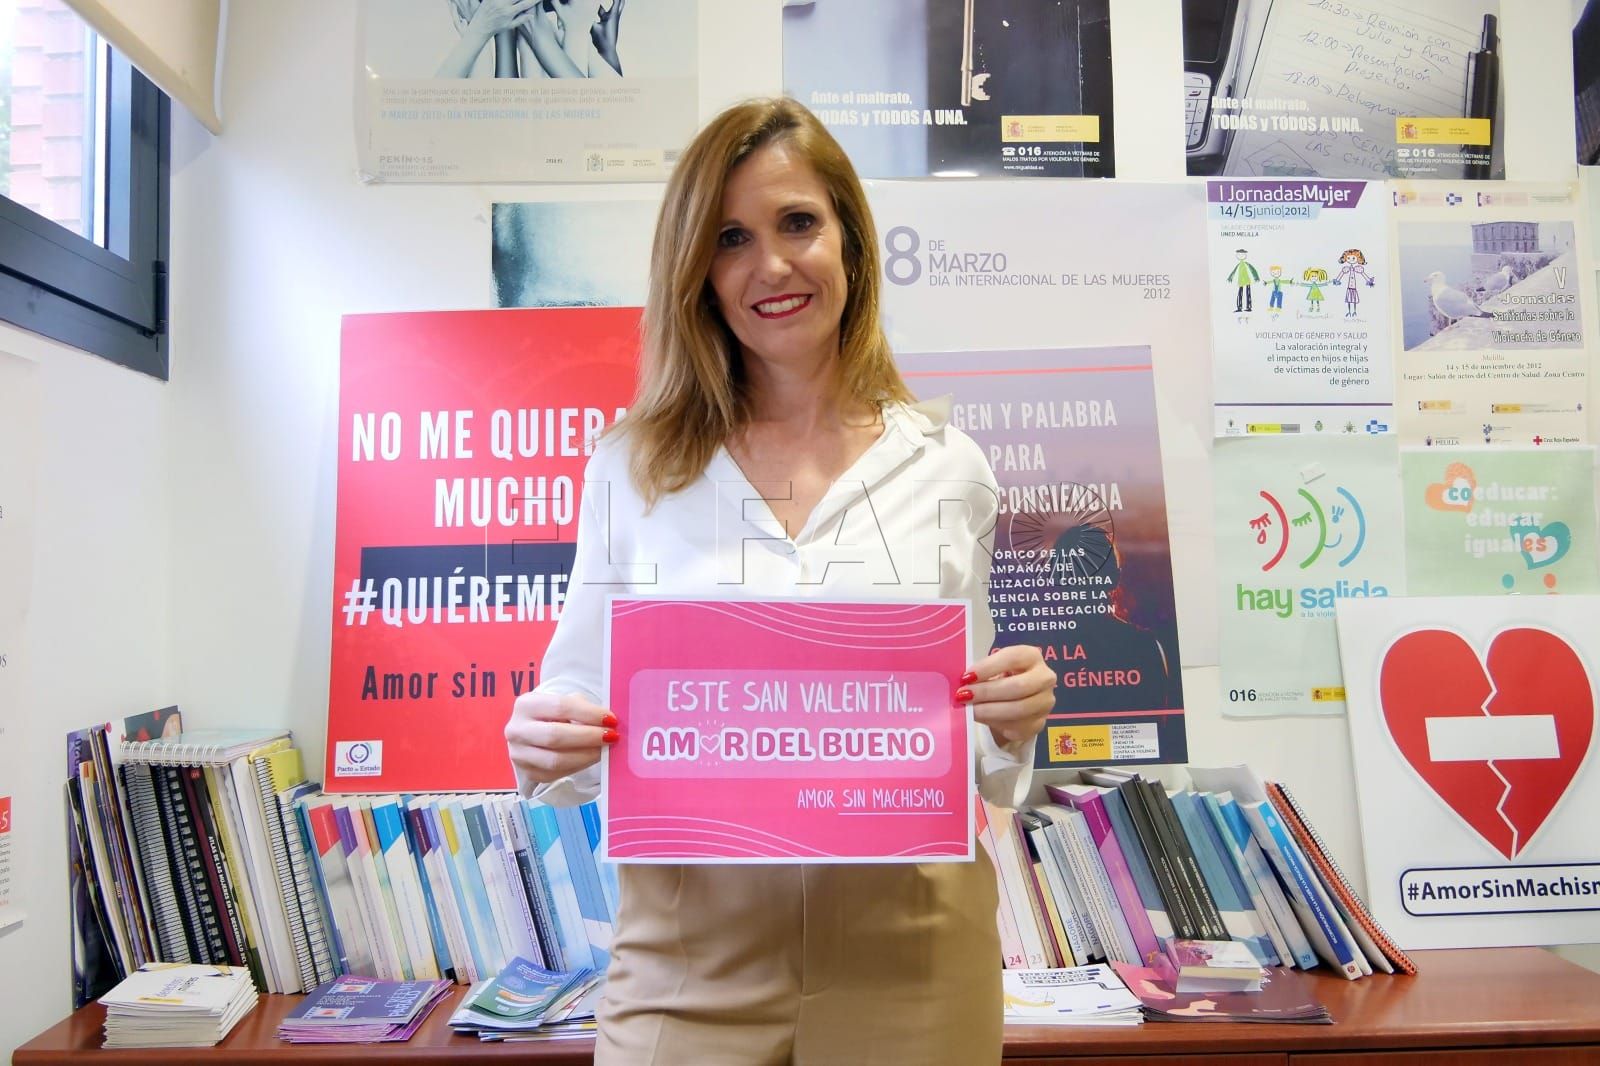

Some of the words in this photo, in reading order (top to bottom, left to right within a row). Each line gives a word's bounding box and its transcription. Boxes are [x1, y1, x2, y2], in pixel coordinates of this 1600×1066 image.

[811, 91, 840, 105] Ante
[842, 91, 854, 105] el
[1211, 96, 1239, 109] Ante
[1241, 97, 1253, 110] el
[862, 112, 870, 127] y
[872, 110, 920, 125] TODOS
[922, 110, 933, 125] A
[935, 109, 968, 125] UNA.
[1211, 115, 1258, 130] TODAS
[1260, 118, 1268, 132] y
[1270, 116, 1316, 131] TODOS
[1319, 117, 1329, 131] A
[1331, 117, 1364, 132] UNA.
[1018, 146, 1042, 156] 016
[1412, 148, 1435, 158] 016
[1228, 184, 1351, 206] JornadasMujer
[928, 240, 945, 251] DE
[885, 225, 922, 286] 8
[928, 252, 1007, 273] MARZO
[929, 272, 950, 287] DÍA
[955, 274, 1056, 286] INTERNACIONAL
[1062, 274, 1078, 286] DE
[1083, 274, 1107, 286] LAS
[1112, 274, 1170, 286] MUJERES
[1553, 266, 1567, 290] V
[1143, 287, 1170, 299] 2012
[1502, 292, 1575, 305] Jornadas
[1491, 307, 1537, 322] Sanitarias
[1538, 308, 1564, 321] sobre
[1565, 308, 1575, 321] la
[1255, 331, 1293, 340] VIOLENCIA
[1294, 331, 1303, 340] DE
[1305, 331, 1335, 340] GÉNERO
[1336, 331, 1341, 340] Y
[1343, 331, 1368, 340] SALUD
[1491, 329, 1535, 343] Violencia
[1537, 329, 1547, 343] de
[1549, 329, 1581, 343] Género
[1275, 342, 1286, 351] La
[1287, 342, 1329, 351] valoración
[1330, 342, 1361, 353] integral
[1362, 344, 1368, 353] y
[1267, 354, 1275, 362] el
[1276, 354, 1309, 363] impacto
[1321, 354, 1341, 364] hijos
[1349, 354, 1369, 364] hijas
[1273, 365, 1284, 374] de
[1286, 365, 1320, 374] víctimas
[1321, 365, 1332, 374] de
[1333, 365, 1369, 374] violencia
[1329, 376, 1340, 385] de
[1341, 376, 1370, 388] género
[953, 402, 993, 431] GEN
[1000, 402, 1012, 430] Y
[1021, 399, 1118, 429] PALABRA
[352, 411, 401, 462] NO
[420, 410, 474, 460] ME
[990, 443, 1047, 472] PARA
[434, 475, 574, 528] MUCHO
[998, 482, 1124, 515] CONCIENCIA
[1465, 508, 1544, 527] educar
[994, 548, 1036, 560] ÓRICO
[1040, 548, 1057, 558] DE
[1062, 547, 1085, 558] LAS
[1464, 533, 1547, 558] iguales
[989, 561, 1052, 574] AMPAÑAS
[1056, 562, 1073, 572] DE
[989, 574, 1055, 589] ILIZACIÓN
[1060, 575, 1112, 587] CONTRA
[342, 566, 568, 628] #QUIÉREME
[1044, 591, 1087, 601] SOBRE
[1091, 591, 1107, 600] LA
[1236, 583, 1293, 618] hay
[991, 608, 1007, 617] DE
[1012, 608, 1028, 617] LA
[1032, 602, 1116, 617] DELEGACIÓN
[1008, 620, 1077, 632] GOBIERNO
[1063, 644, 1087, 661] LA
[361, 665, 439, 701] Amor
[452, 663, 496, 698] sin
[1063, 667, 1141, 688] GÉNERO
[667, 680, 731, 713] ESTE
[742, 681, 788, 713] SAN
[799, 674, 923, 713] VALENTÍN...
[1229, 689, 1257, 702] 016
[751, 728, 816, 762] DEL
[819, 728, 935, 762] BUENO
[797, 789, 836, 809] AMOR
[842, 789, 866, 809] SIN
[872, 788, 945, 809] MACHISMO
[208, 835, 216, 854] ATLAS
[218, 873, 229, 900] MUJERES
[1065, 918, 1082, 952] NAGORE
[1082, 912, 1100, 946] NAGORE
[1008, 954, 1022, 966] 24
[1030, 953, 1043, 965] 23
